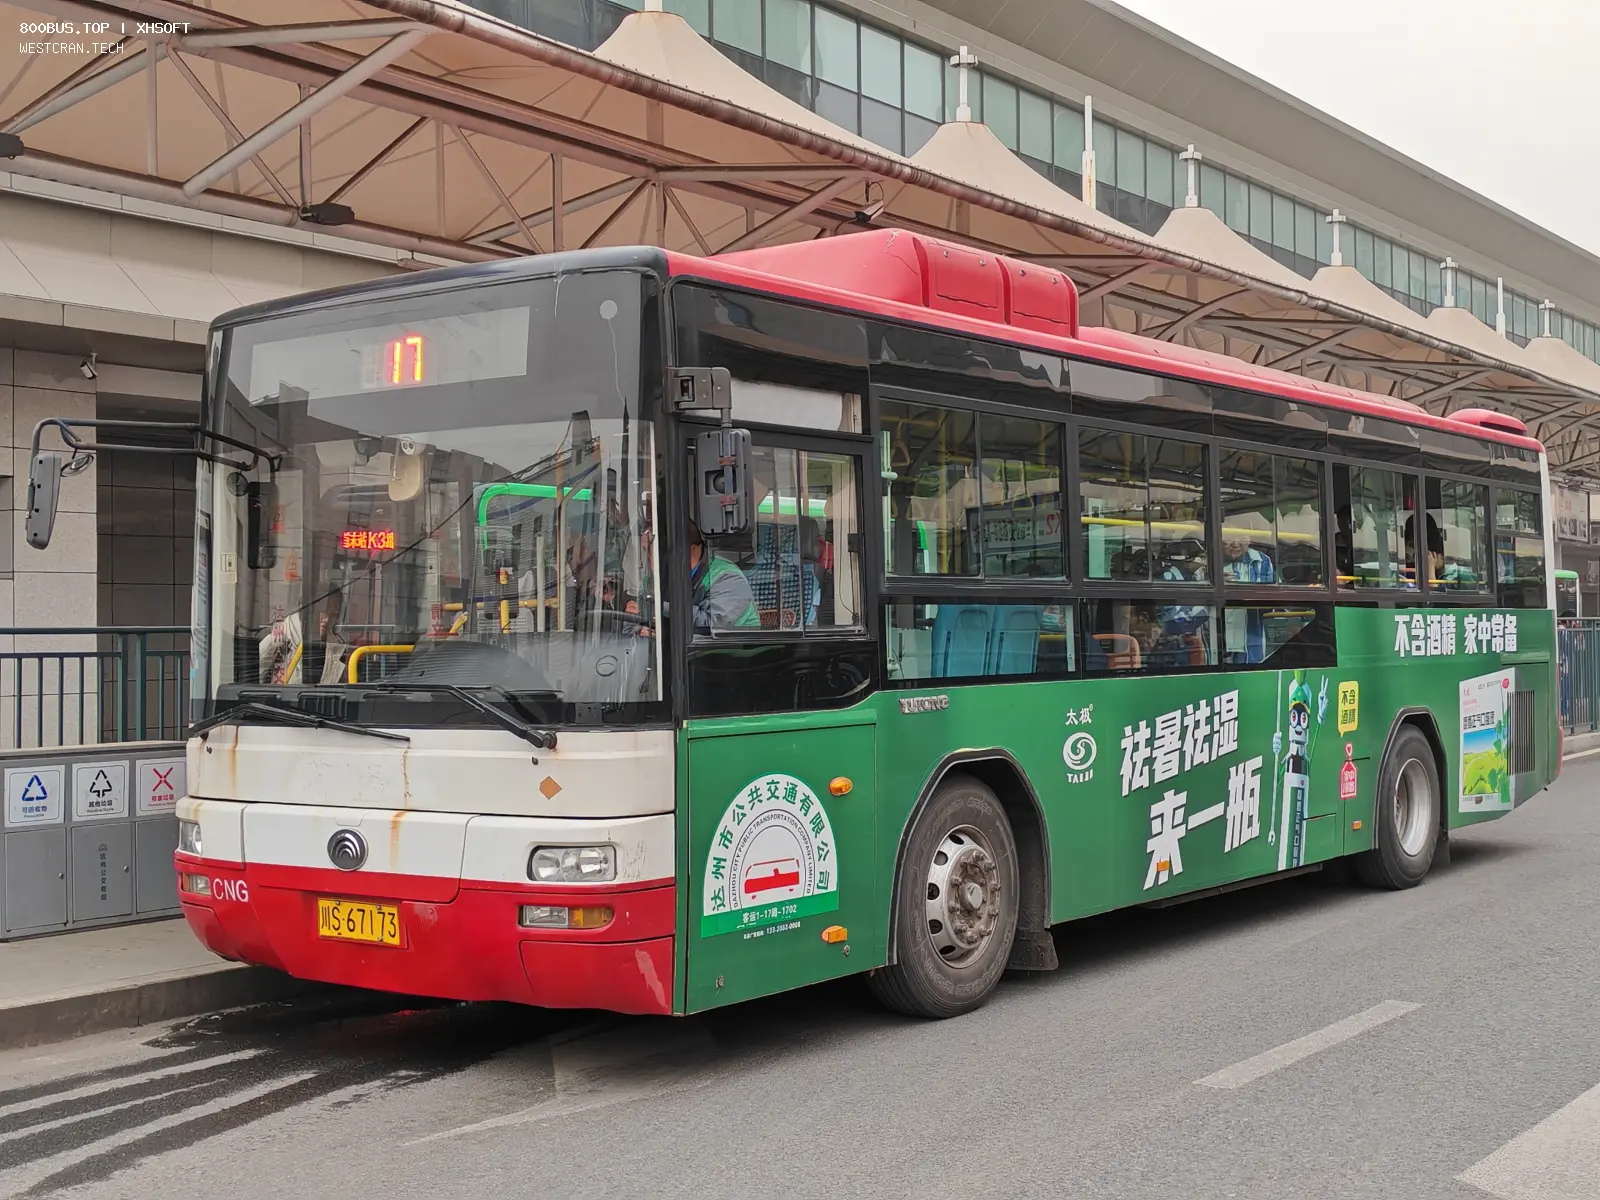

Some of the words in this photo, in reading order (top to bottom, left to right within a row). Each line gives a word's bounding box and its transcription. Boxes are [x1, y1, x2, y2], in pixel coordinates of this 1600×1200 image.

[391, 335, 424, 384] 17
[1394, 613, 1456, 658] 不含酒精
[1463, 612, 1518, 655] 家中常备
[898, 695, 950, 714] YUTONG
[1065, 707, 1092, 726] 太极
[1120, 689, 1239, 798] 祛暑祛湿
[1066, 768, 1094, 784] TAIJI
[753, 813, 799, 832] TRANSPORTATION
[1143, 755, 1263, 891] 来一瓶
[710, 779, 830, 911] 达州市公共交通有限公司
[212, 878, 249, 903] CNG
